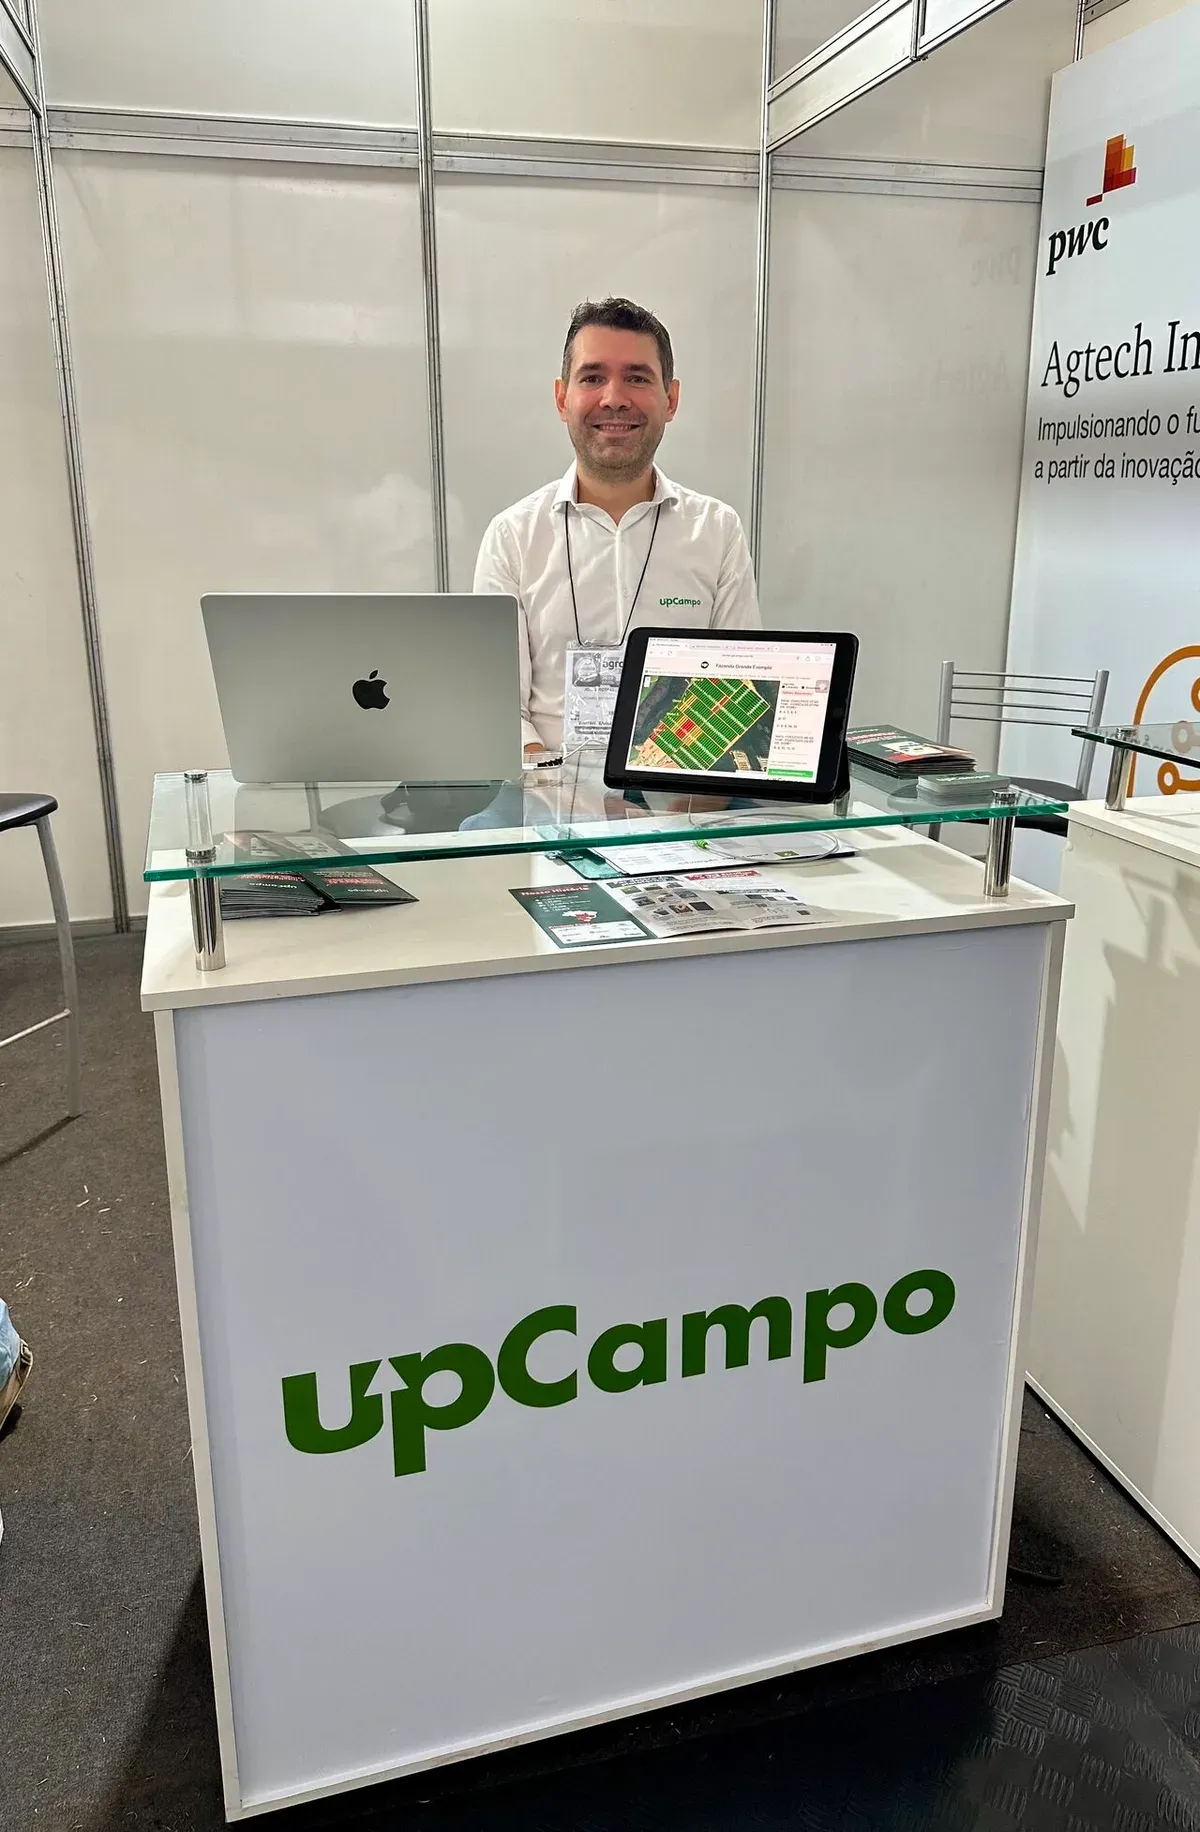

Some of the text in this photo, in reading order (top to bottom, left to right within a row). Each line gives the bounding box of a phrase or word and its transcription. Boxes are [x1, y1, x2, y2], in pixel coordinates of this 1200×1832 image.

[1046, 215, 1110, 276] pwc
[1041, 320, 1200, 398] Agtech In
[1038, 408, 1161, 446] Impulsionando
[1167, 413, 1180, 435] o
[1034, 460, 1044, 479] a
[1048, 453, 1091, 485] partir
[1094, 453, 1115, 479] da
[659, 597, 702, 608] upCampo
[281, 1268, 957, 1478] upCampo
